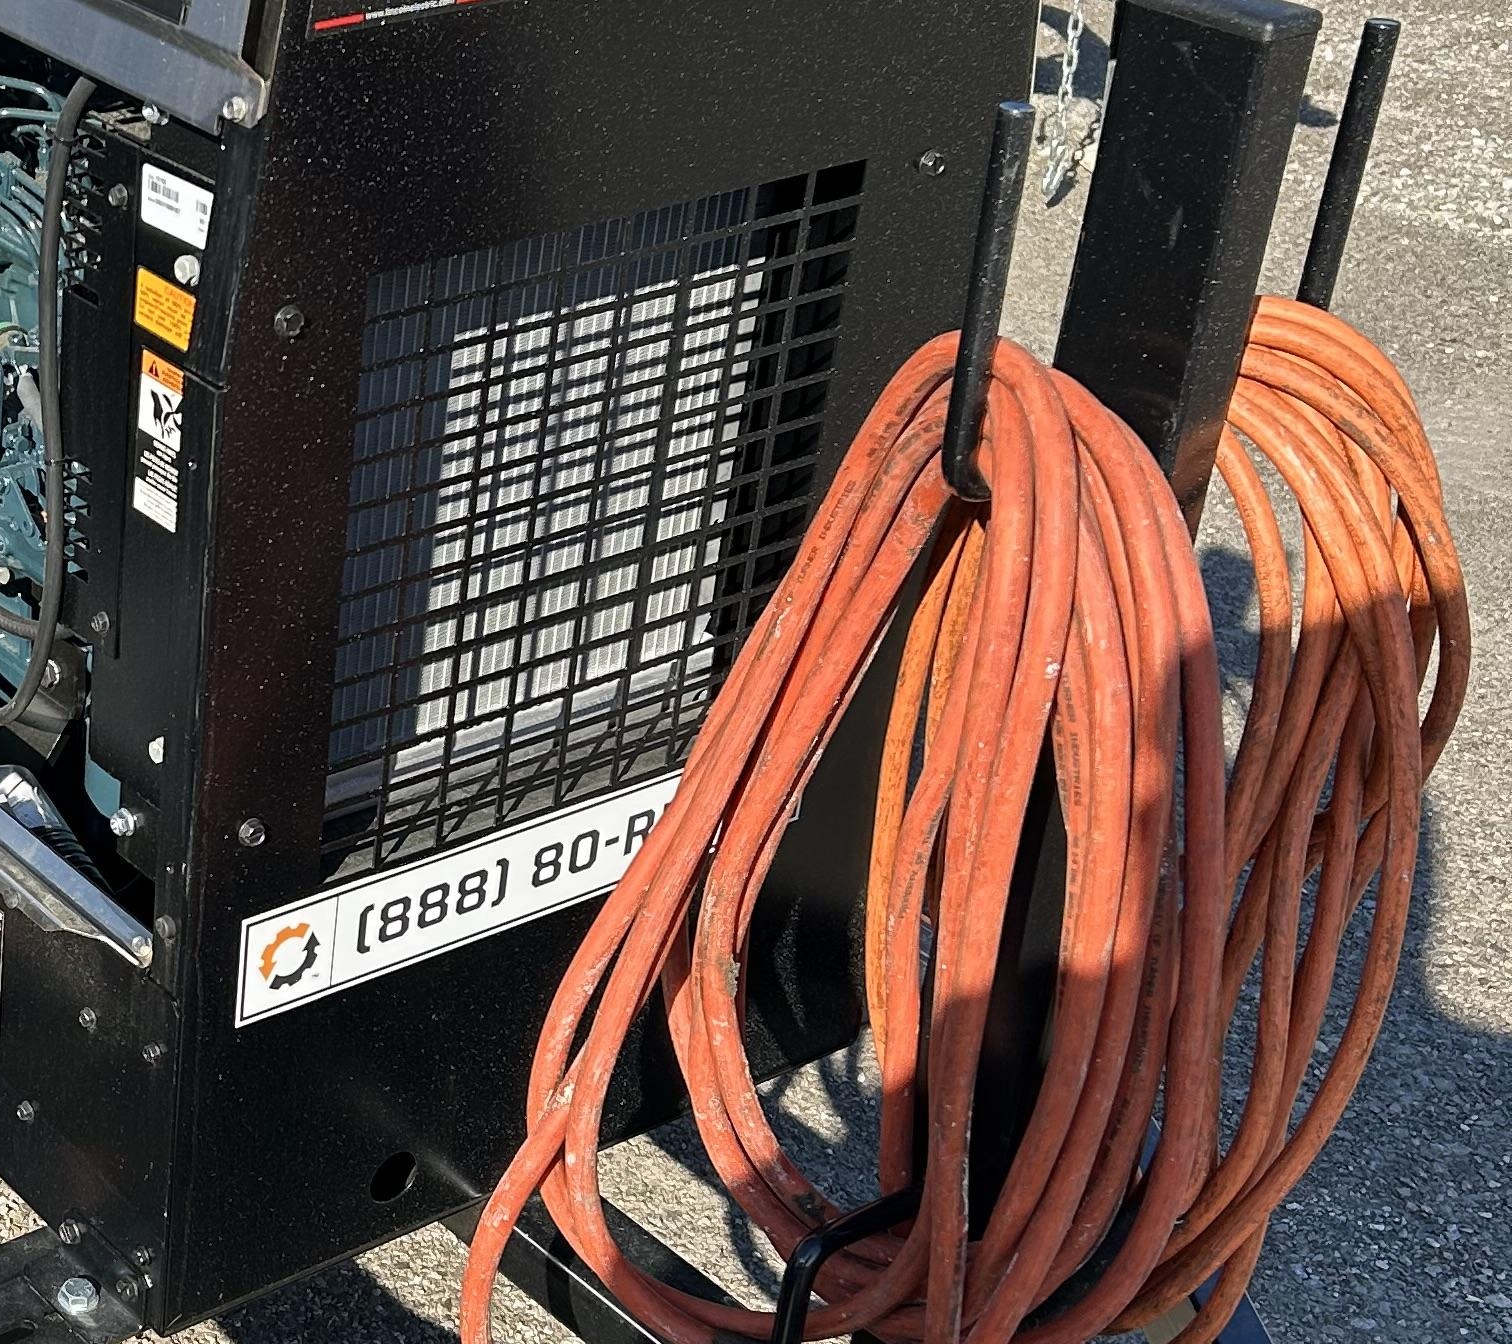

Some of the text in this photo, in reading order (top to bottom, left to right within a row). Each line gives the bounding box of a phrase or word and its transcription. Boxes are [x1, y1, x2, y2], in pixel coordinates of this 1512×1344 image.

[796, 545, 820, 585] TURNER
[1069, 732, 1083, 807] INDUSTRIES
[356, 804, 666, 955] (888) 80-R
